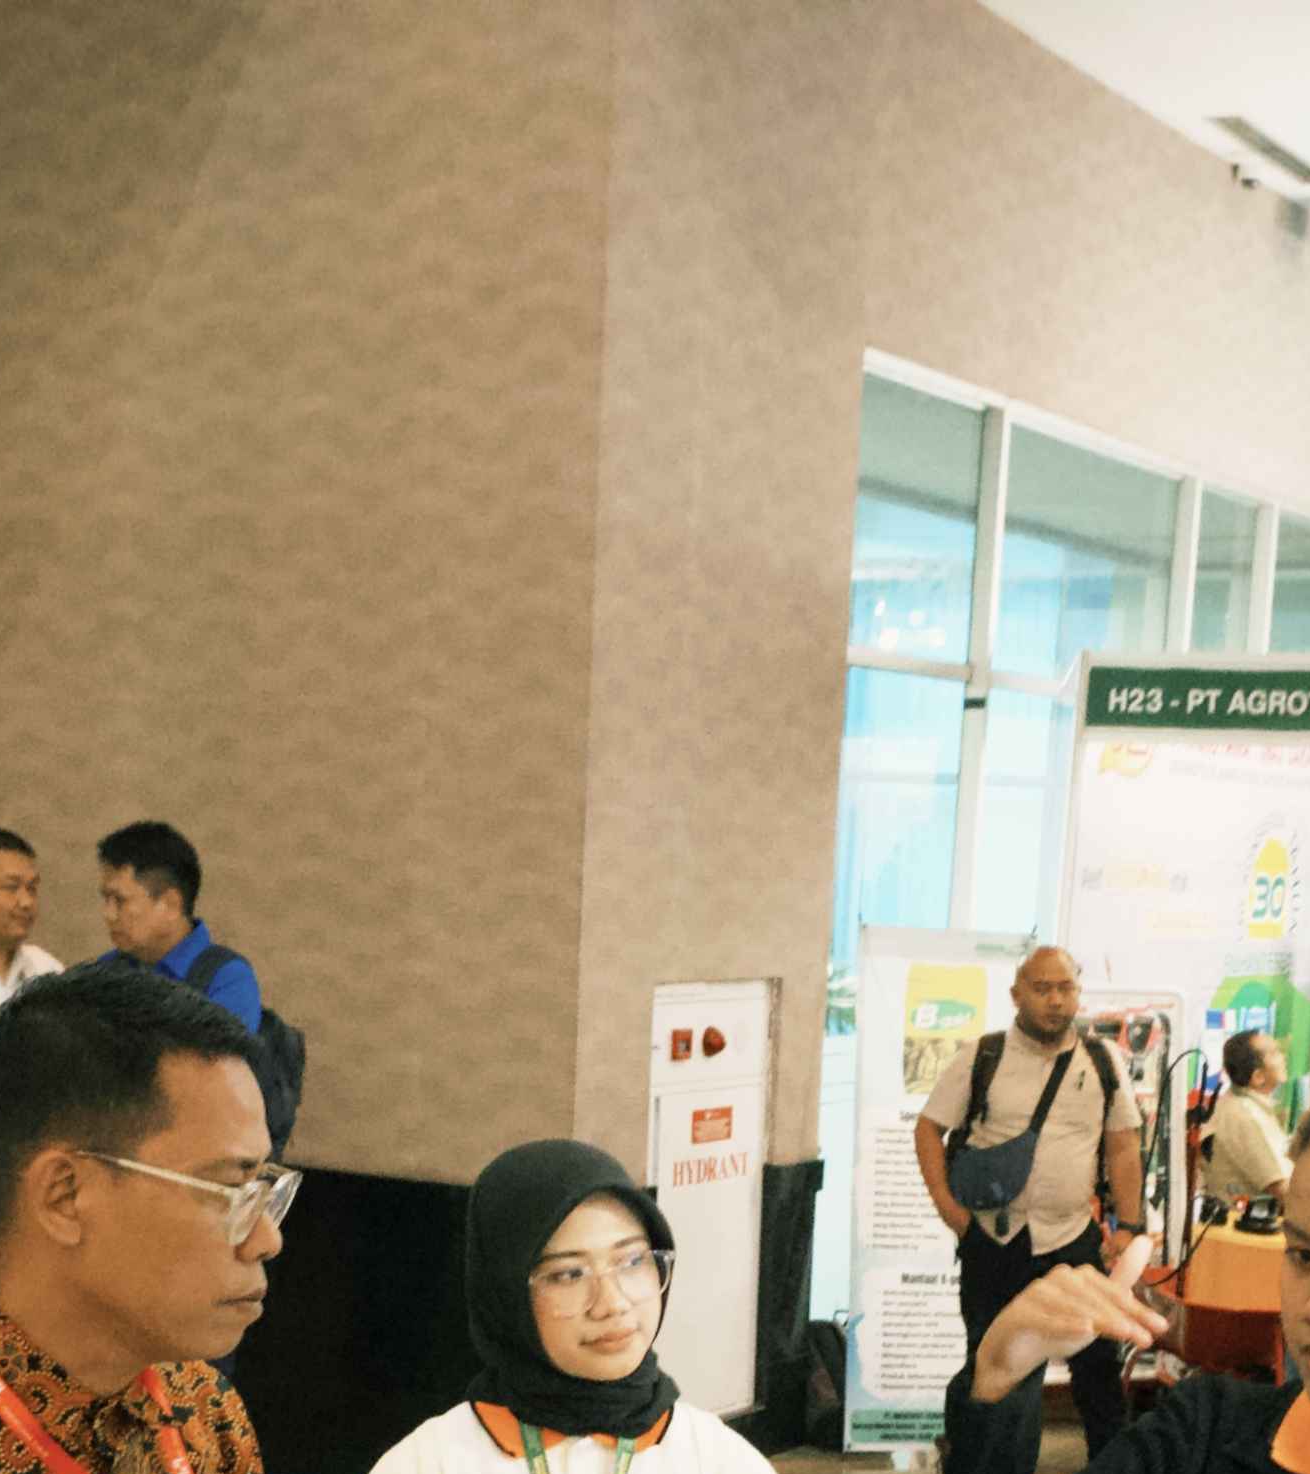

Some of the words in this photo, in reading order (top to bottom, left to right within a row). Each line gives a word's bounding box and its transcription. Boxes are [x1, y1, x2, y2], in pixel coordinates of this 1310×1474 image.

[1108, 687, 1164, 714] H23
[1186, 688, 1223, 714] PT
[672, 1151, 749, 1189] HYDRANT
